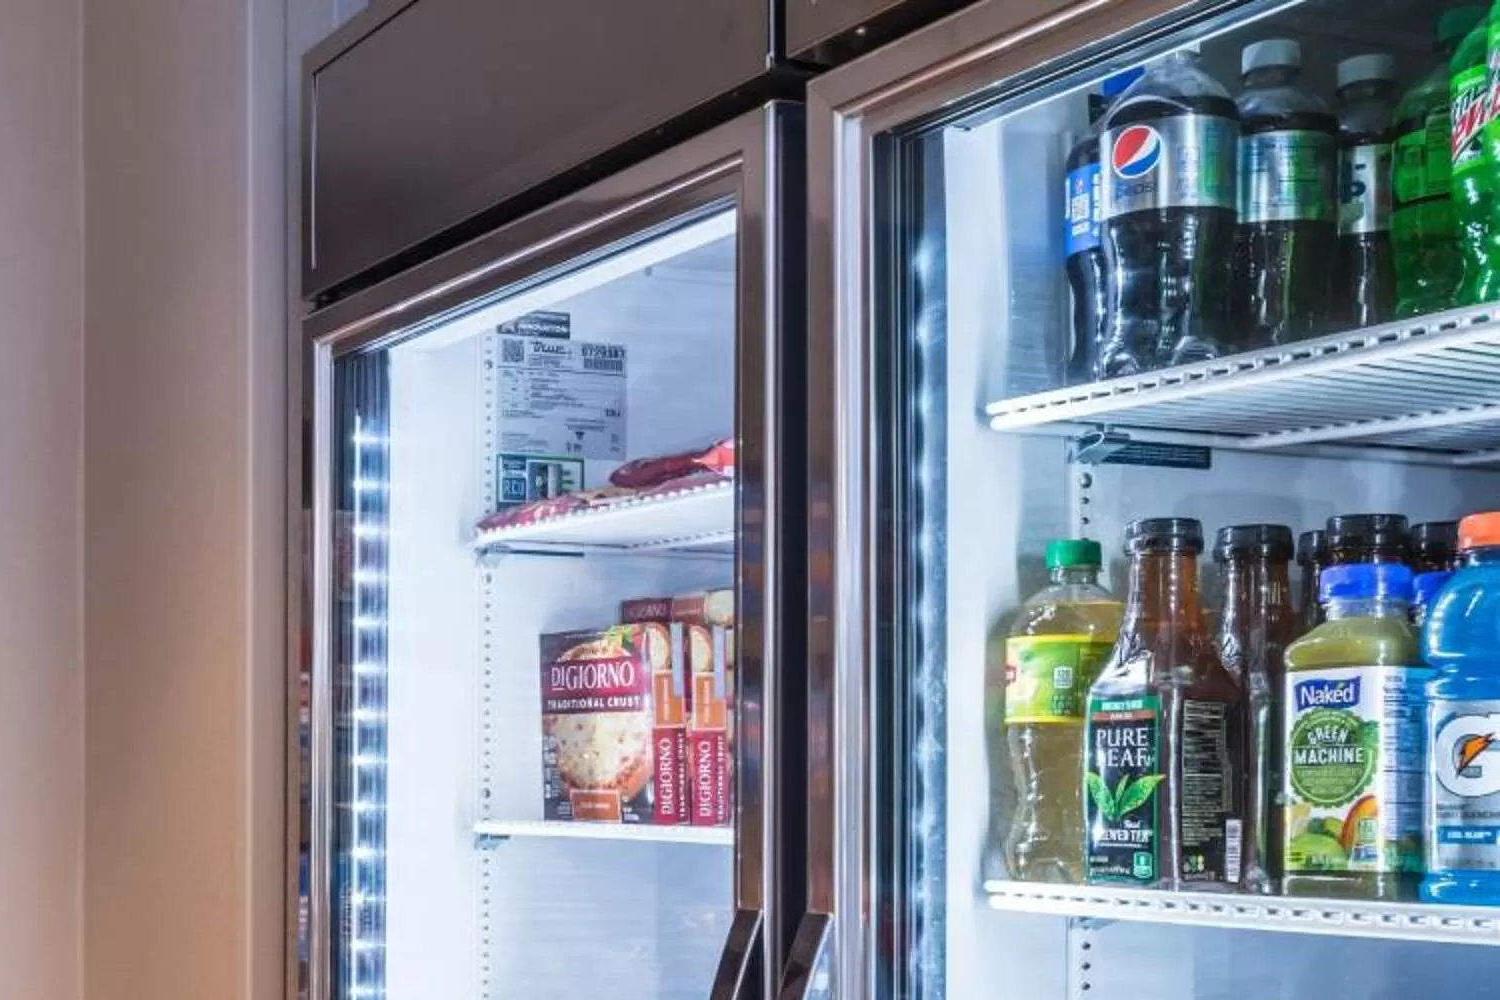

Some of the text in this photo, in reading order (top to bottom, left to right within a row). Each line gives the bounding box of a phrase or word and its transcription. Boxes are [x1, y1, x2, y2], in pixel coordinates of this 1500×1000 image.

[548, 695, 640, 709] TRADITIONAL CRUST
[1096, 728, 1148, 748] PURE
[1308, 727, 1348, 746] GREEN
[1294, 747, 1364, 765] MACHINE
